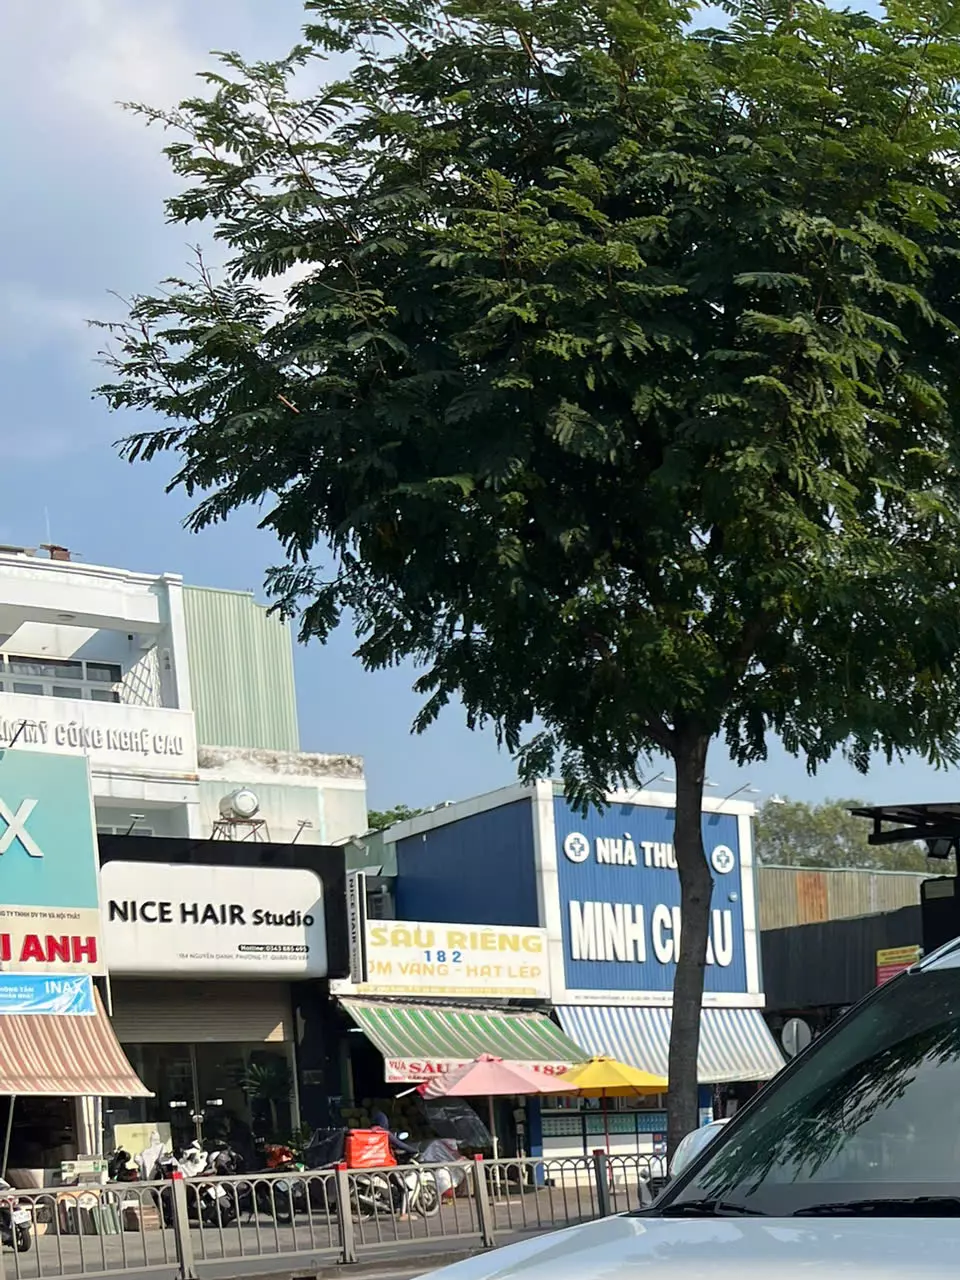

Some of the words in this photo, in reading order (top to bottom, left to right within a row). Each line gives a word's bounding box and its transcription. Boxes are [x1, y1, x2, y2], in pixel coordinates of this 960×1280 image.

[0, 718, 18, 742] M
[596, 832, 637, 866] NHÀ
[641, 841, 679, 869] THU
[109, 900, 173, 923] NICE
[181, 903, 246, 925] HAIR
[252, 908, 315, 927] Studio
[570, 900, 646, 963] MINH
[652, 904, 733, 967] CU
[19, 935, 97, 963] ANH
[44, 980, 84, 994] INAX
